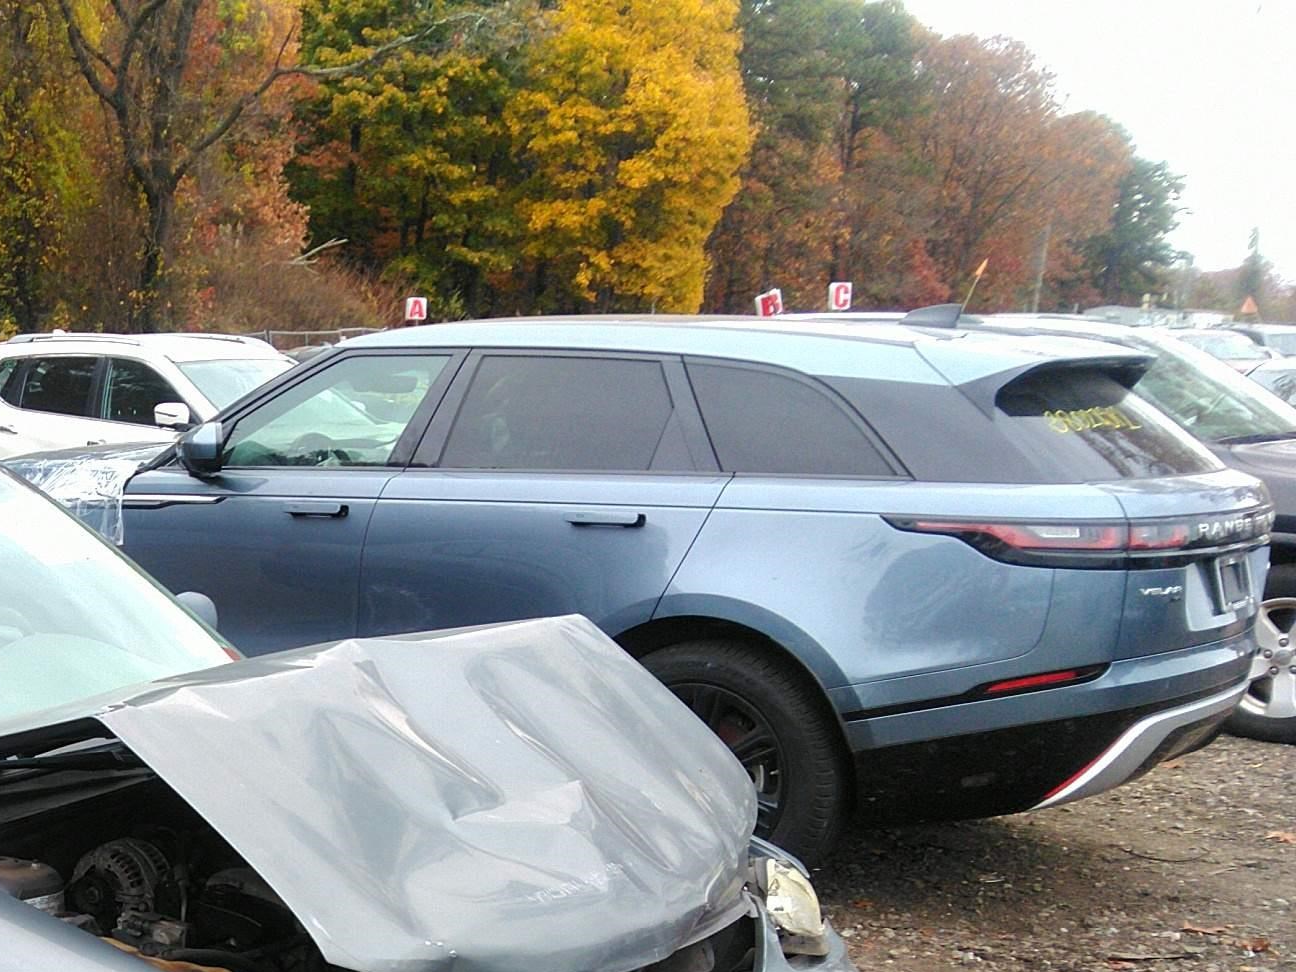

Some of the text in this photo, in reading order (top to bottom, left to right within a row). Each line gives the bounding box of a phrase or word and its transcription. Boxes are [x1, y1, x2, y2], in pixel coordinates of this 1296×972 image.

[761, 294, 780, 316] B
[835, 285, 849, 308] C
[409, 299, 425, 318] A
